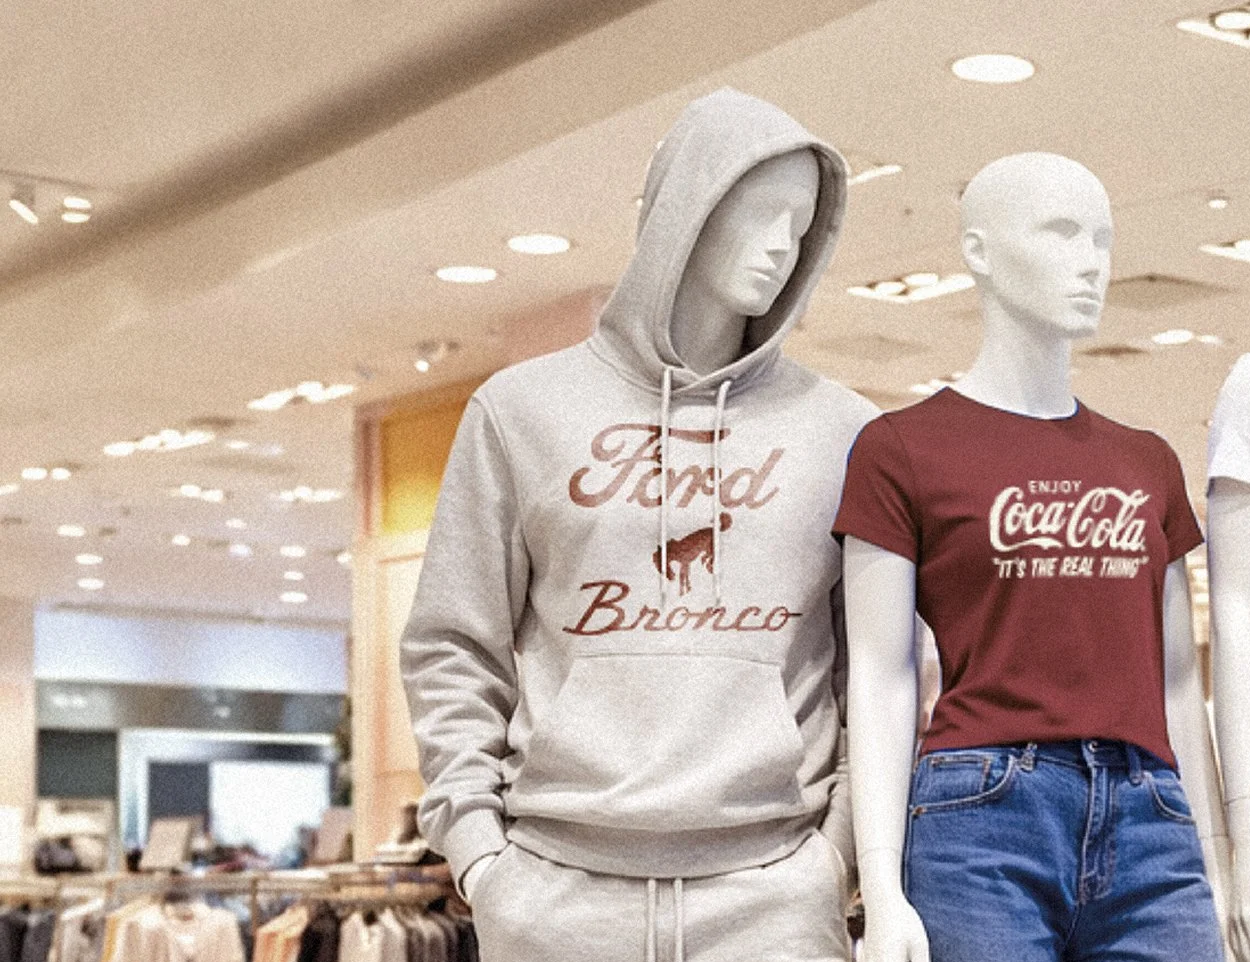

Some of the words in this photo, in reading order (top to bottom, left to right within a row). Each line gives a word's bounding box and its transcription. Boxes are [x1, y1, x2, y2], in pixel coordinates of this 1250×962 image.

[569, 423, 785, 509] Ford
[1028, 480, 1083, 494] ENJOY
[989, 486, 1151, 552] Coca-Cola
[1031, 556, 1059, 578] THE
[1059, 555, 1095, 577] REAL
[562, 579, 801, 636] Bronco
